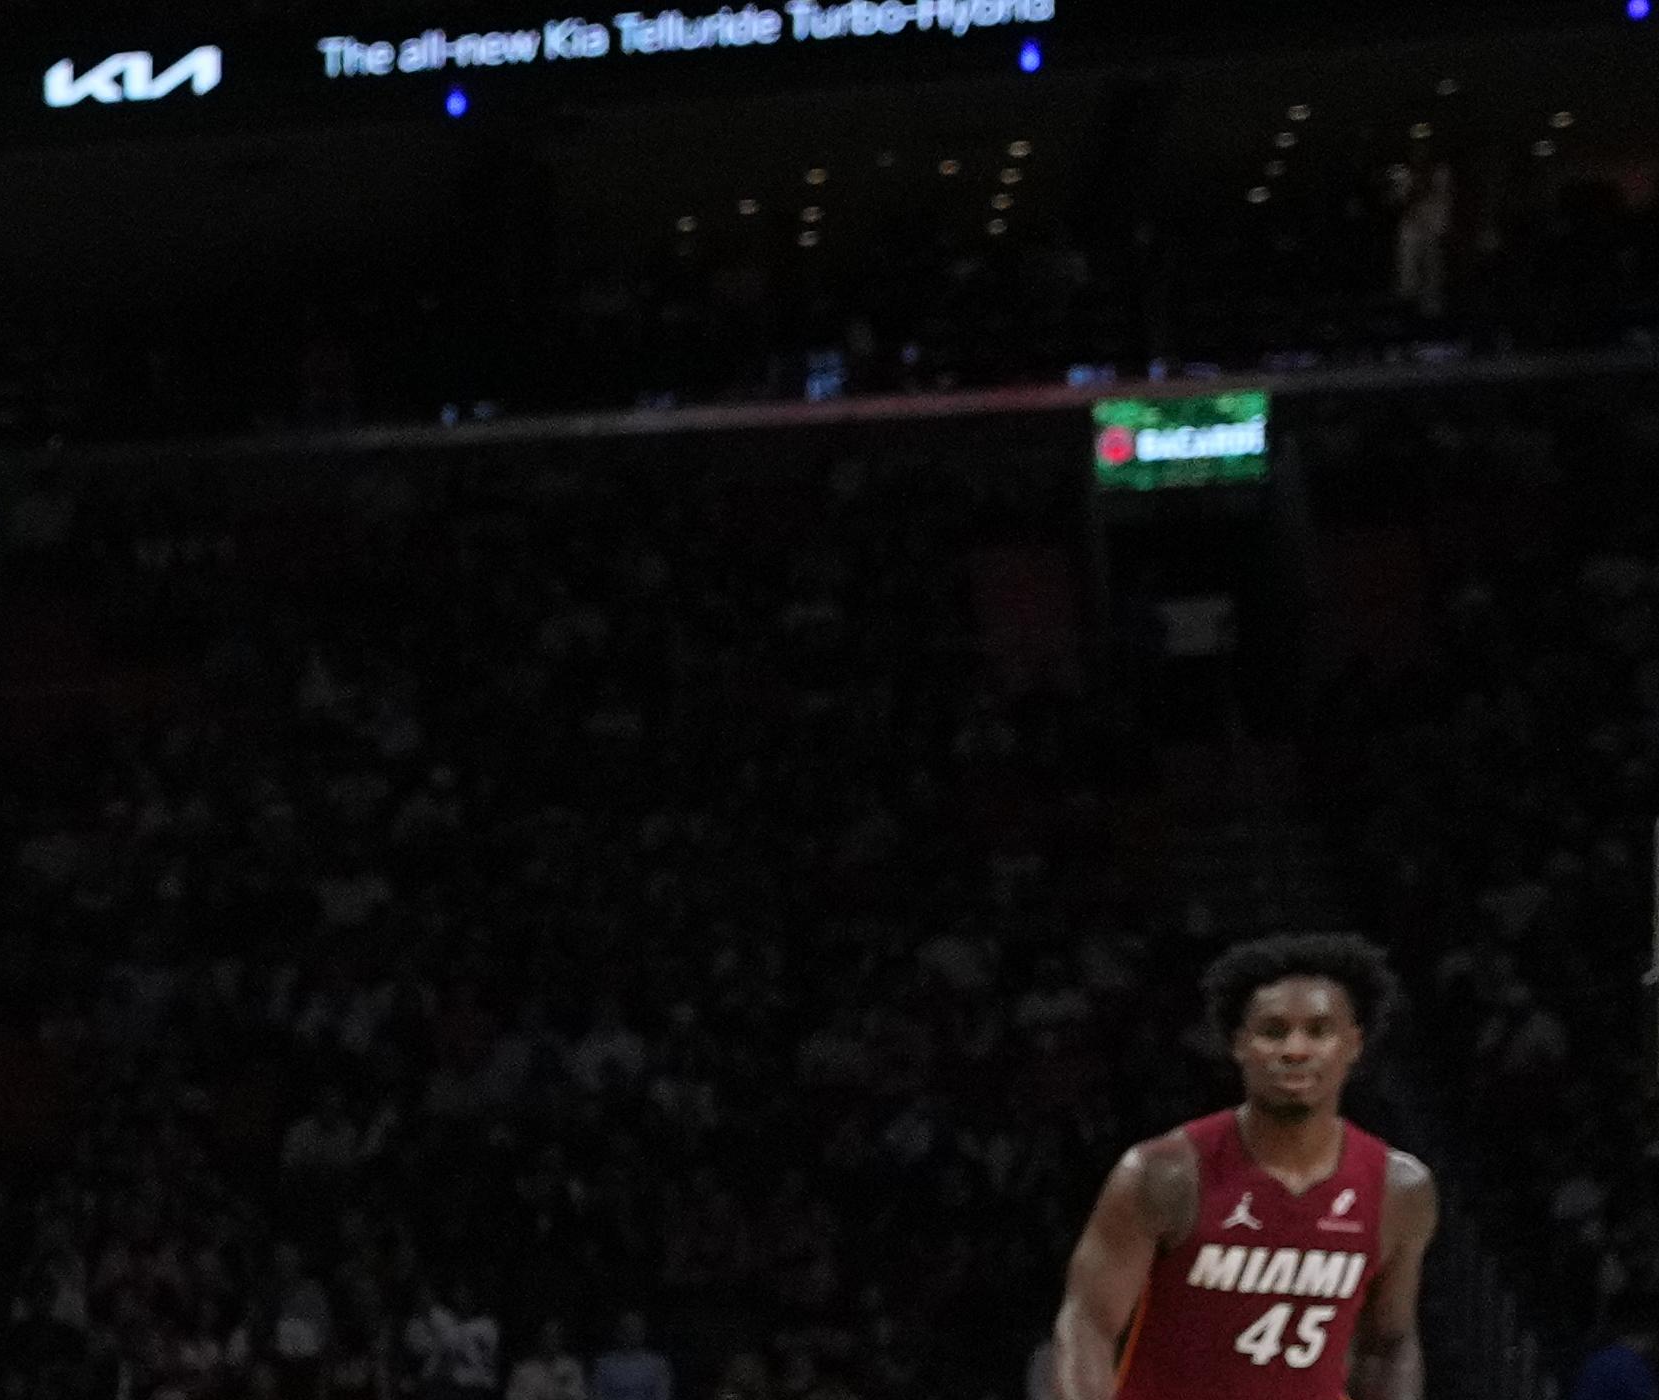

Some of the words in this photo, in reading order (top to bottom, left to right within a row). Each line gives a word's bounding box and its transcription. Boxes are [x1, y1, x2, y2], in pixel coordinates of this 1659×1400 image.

[318, 36, 395, 77] The
[397, 29, 541, 73] all-new
[543, 17, 610, 60] Kia
[613, 4, 782, 54] Telluride
[784, 0, 1055, 41] Turbo-Hybrid
[1187, 1243, 1368, 1299] MIAMI
[1234, 1302, 1337, 1369] 45
